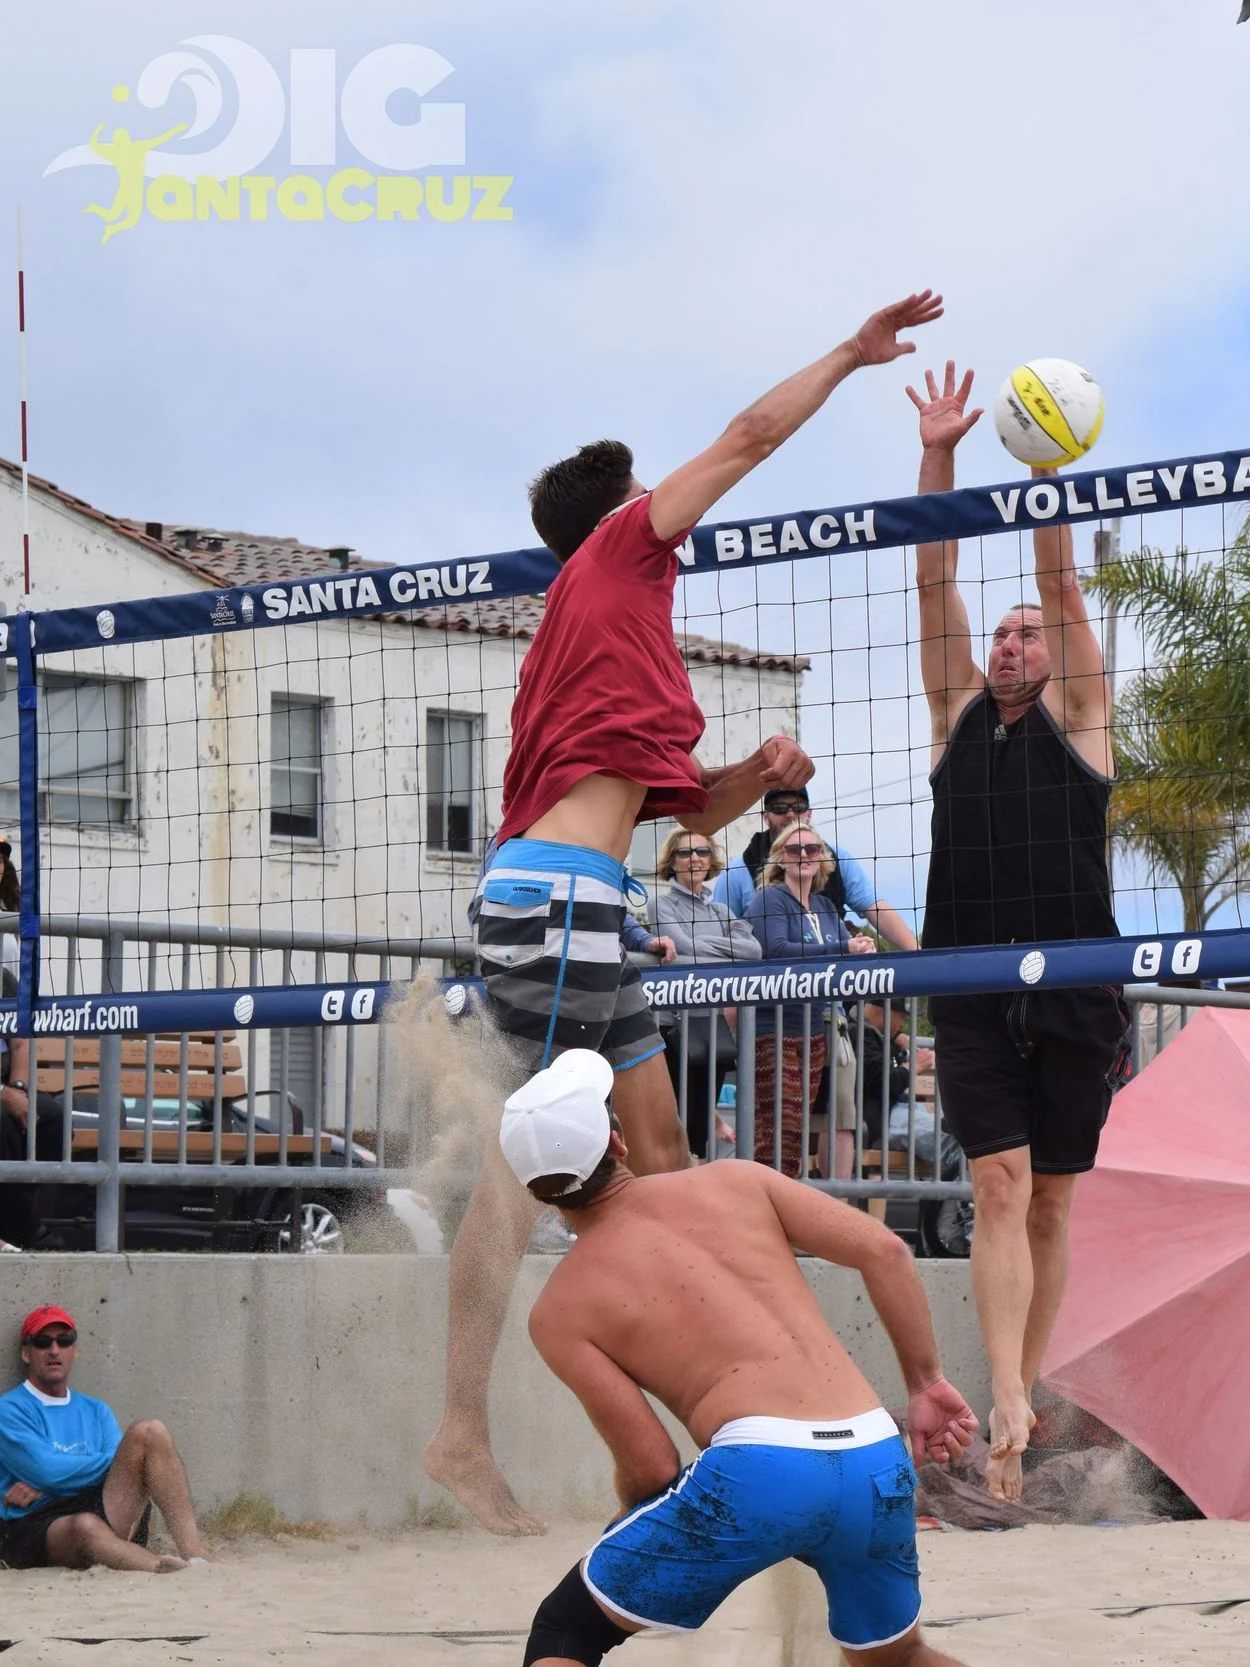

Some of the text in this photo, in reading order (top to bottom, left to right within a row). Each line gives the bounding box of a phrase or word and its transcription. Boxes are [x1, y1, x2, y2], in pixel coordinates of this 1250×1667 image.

[715, 509, 877, 562] BEACH
[262, 576, 382, 619] SANTA
[389, 561, 493, 603] CRUZ
